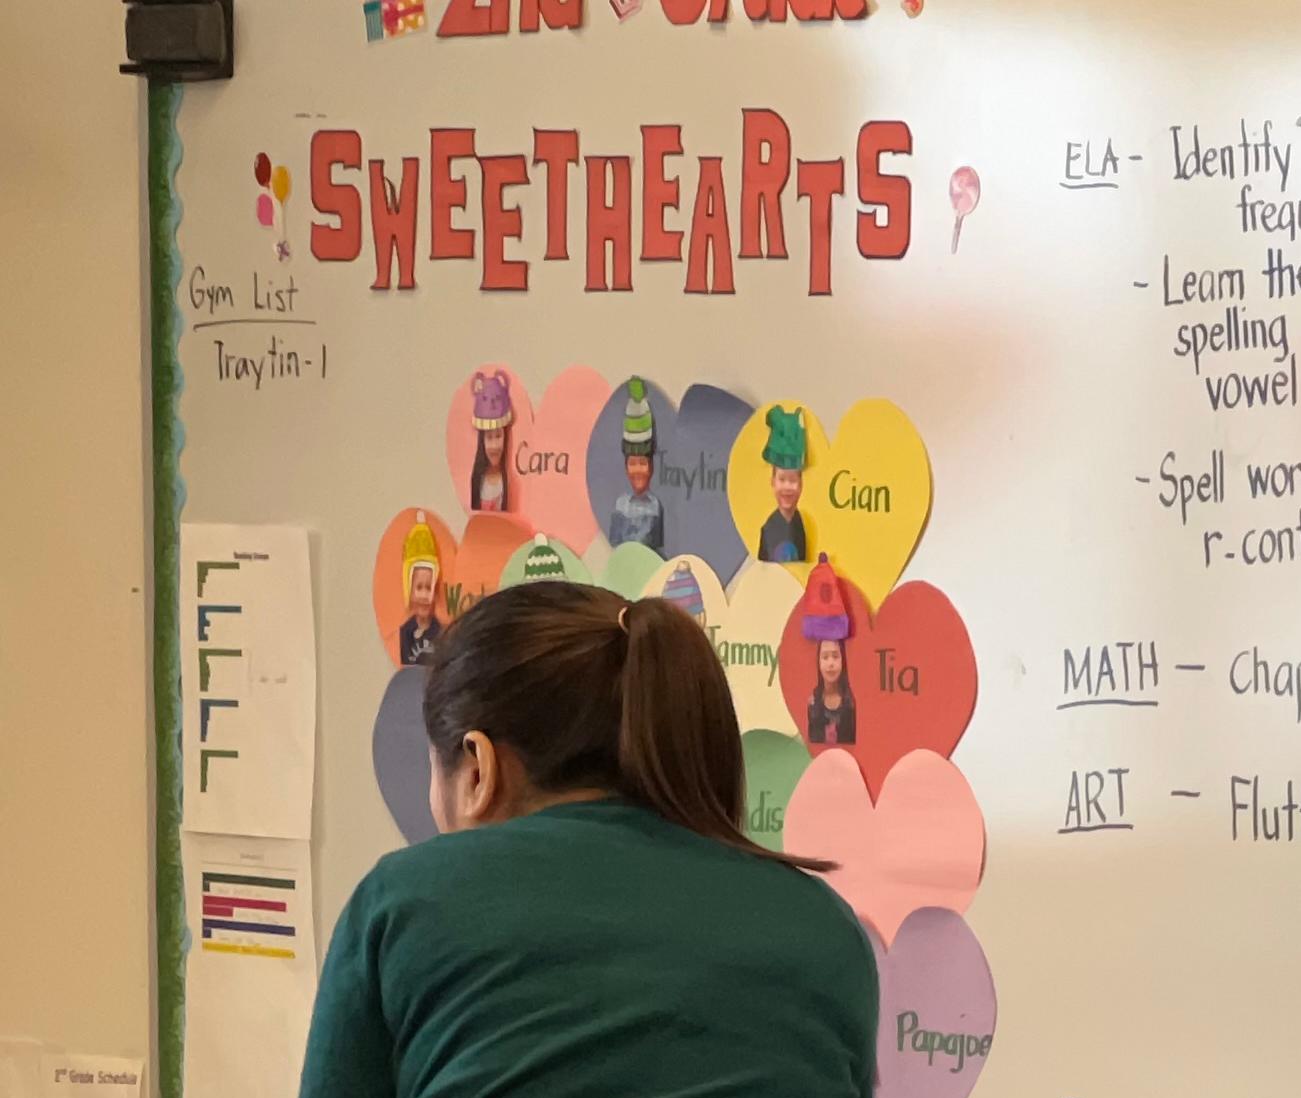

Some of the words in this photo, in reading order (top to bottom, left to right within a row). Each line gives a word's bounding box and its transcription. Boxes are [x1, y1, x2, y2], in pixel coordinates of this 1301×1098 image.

[1169, 118, 1292, 192] Identify
[310, 108, 913, 297] SWEETHEARTS
[189, 265, 235, 316] Gym
[253, 271, 300, 313] List
[1172, 305, 1290, 376] spelling
[1206, 353, 1297, 411] vowel
[515, 441, 570, 477] Cara
[828, 469, 891, 514] Cian
[874, 647, 921, 696] Tia
[1062, 640, 1159, 696] MATH
[1064, 768, 1130, 828] ART
